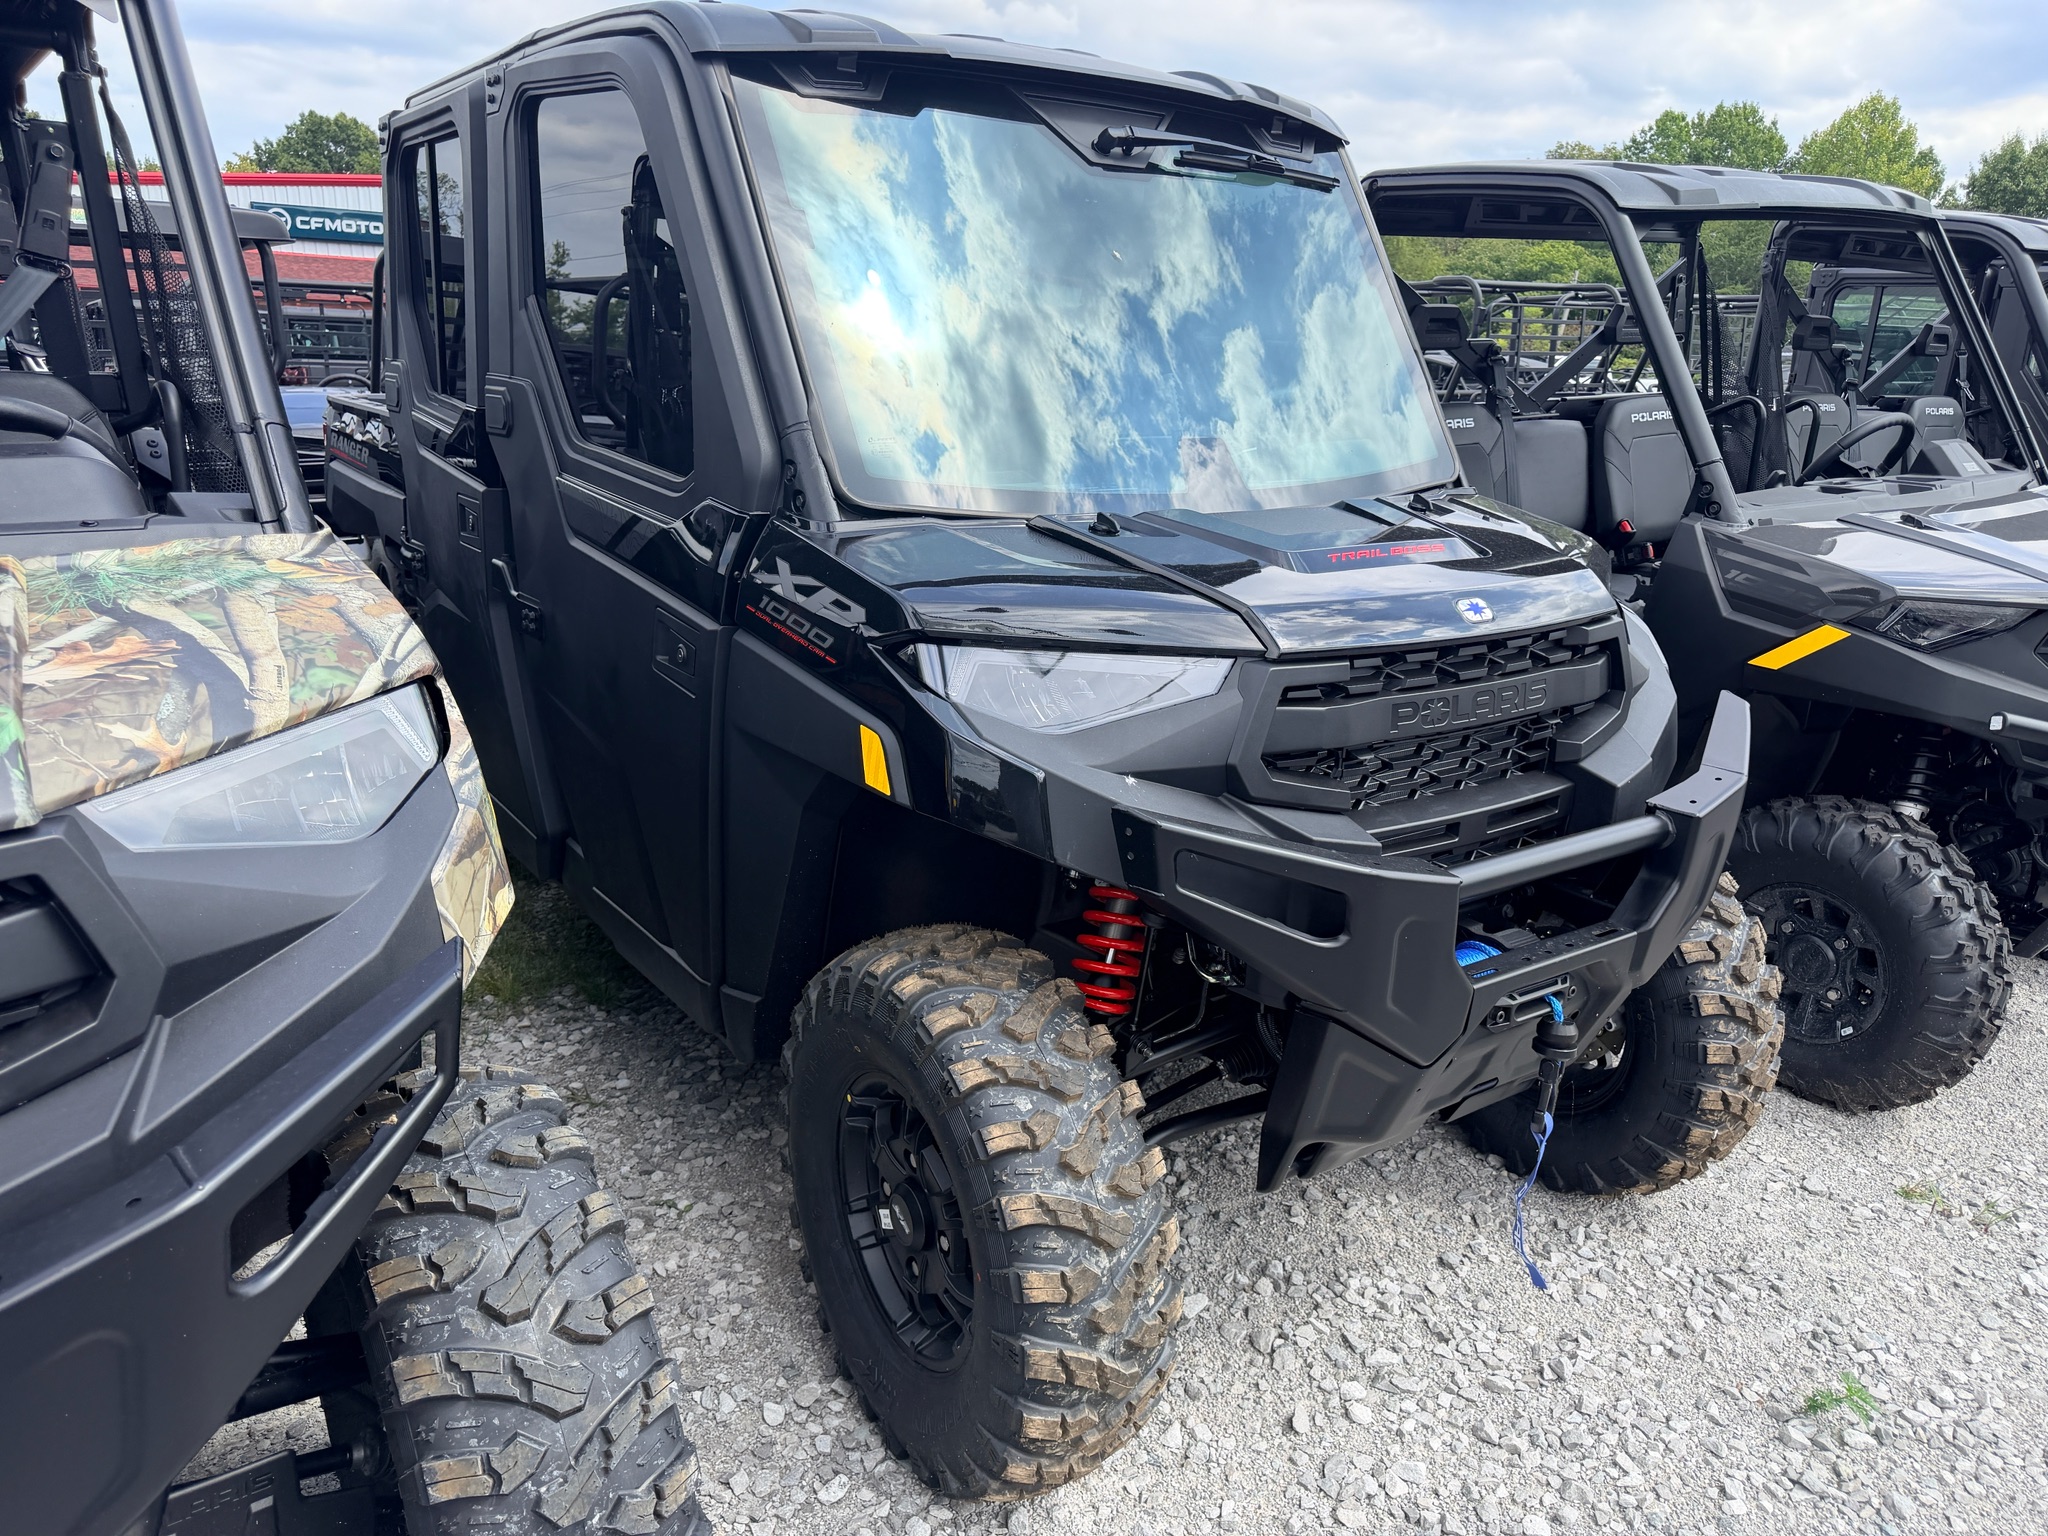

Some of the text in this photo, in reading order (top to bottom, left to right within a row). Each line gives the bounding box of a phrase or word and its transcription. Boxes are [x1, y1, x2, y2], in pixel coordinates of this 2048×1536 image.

[296, 216, 384, 235] CFMOTO
[1446, 418, 1475, 429] ARIS
[1802, 404, 1836, 412] PARIS
[1925, 407, 1954, 416] POLARIS
[330, 432, 369, 464] RANGER
[1327, 544, 1446, 563] TRAIL BOSS
[751, 556, 867, 629] XP
[755, 611, 827, 658] DUAL OVERHEAD CAM
[759, 595, 835, 649] 1000
[1390, 678, 1547, 733] POLARIS
[167, 1472, 274, 1528] LARIS
